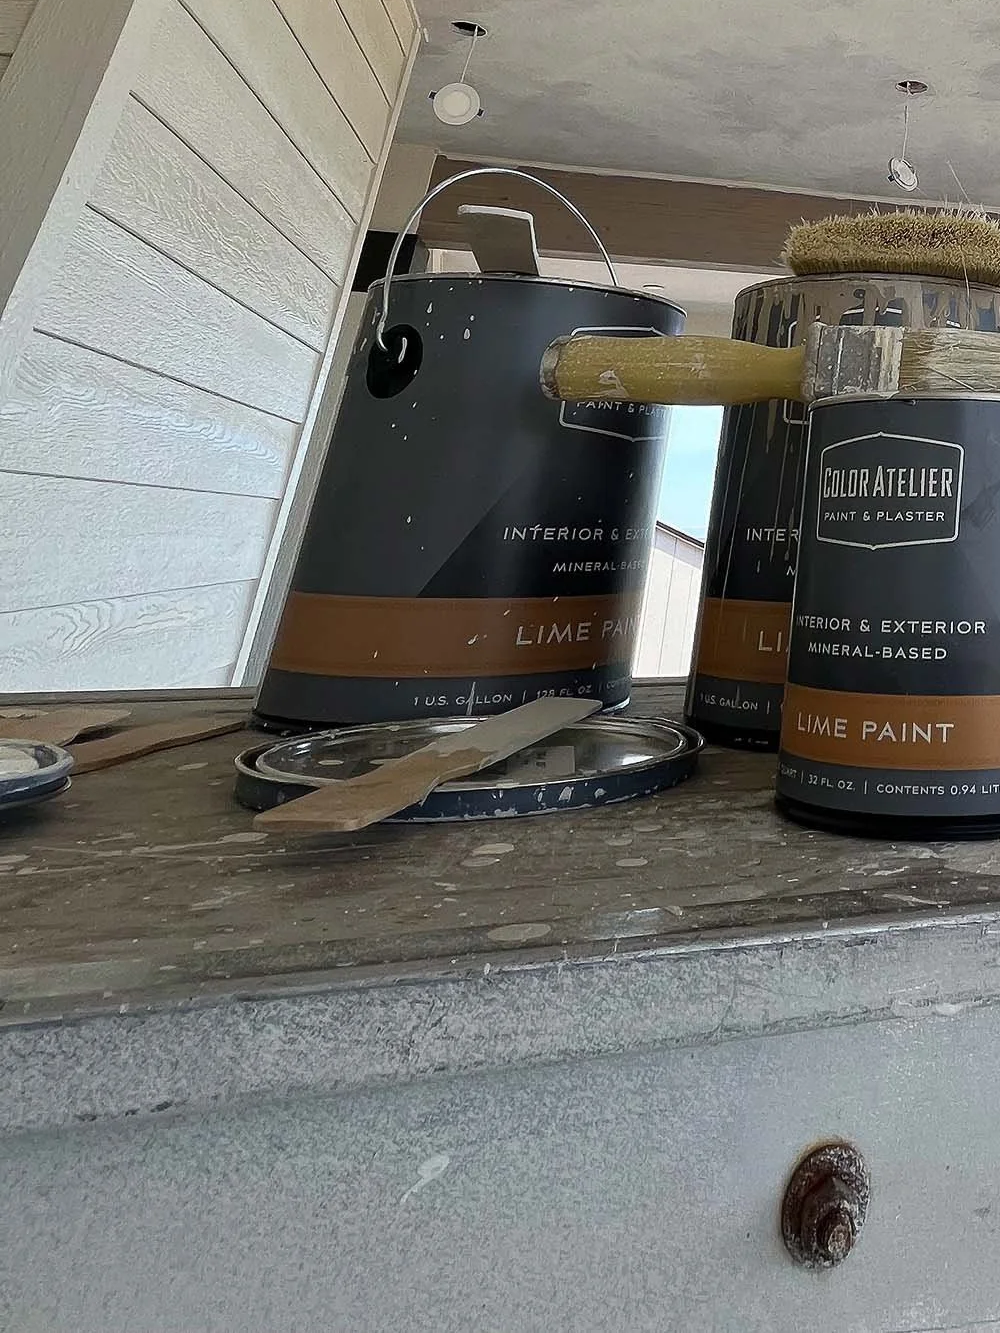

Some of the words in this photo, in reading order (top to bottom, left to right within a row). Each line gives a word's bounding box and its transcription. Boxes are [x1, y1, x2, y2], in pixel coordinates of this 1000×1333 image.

[627, 404, 636, 413] &
[824, 511, 857, 522] PAINT
[863, 510, 871, 521] &
[876, 511, 945, 522] PLASTER
[503, 525, 604, 541] INTERIOR
[610, 528, 620, 541] &
[516, 621, 592, 646] LIME
[859, 619, 871, 633] &
[881, 621, 986, 635] EXTERIOR
[758, 629, 791, 653] LI
[808, 641, 948, 660] MINERAL-BASED
[413, 698, 420, 706] 1
[425, 697, 449, 707] U.S.
[455, 693, 512, 706] GALLON
[797, 712, 849, 739] LIME
[862, 720, 955, 744] PAINT
[808, 774, 819, 786] 32
[876, 783, 946, 796] CONTENTS
[950, 784, 977, 796] 0.94
